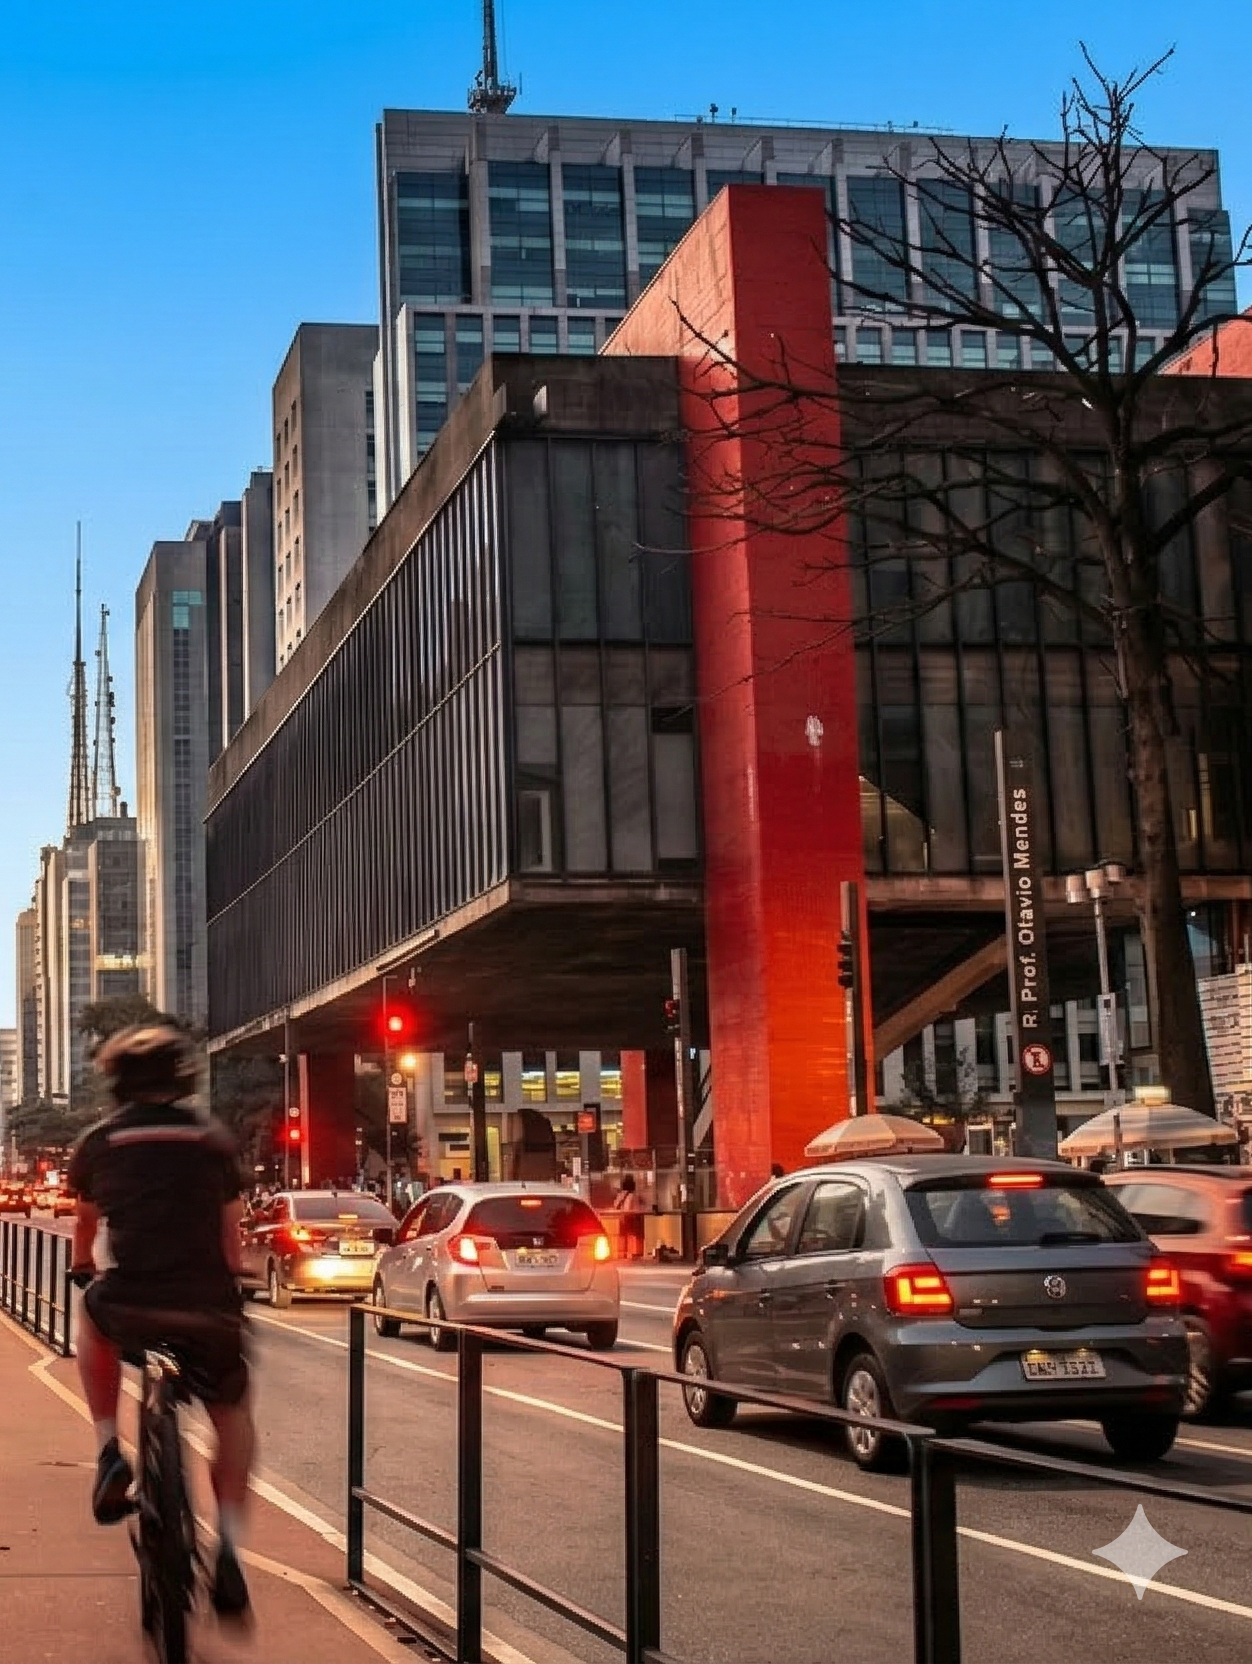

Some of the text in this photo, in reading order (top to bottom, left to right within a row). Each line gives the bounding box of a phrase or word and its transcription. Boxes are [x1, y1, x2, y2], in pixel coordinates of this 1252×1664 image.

[1010, 788, 1031, 869] Mendes
[1015, 876, 1035, 945] Otavio
[1019, 953, 1038, 1002] Prof.
